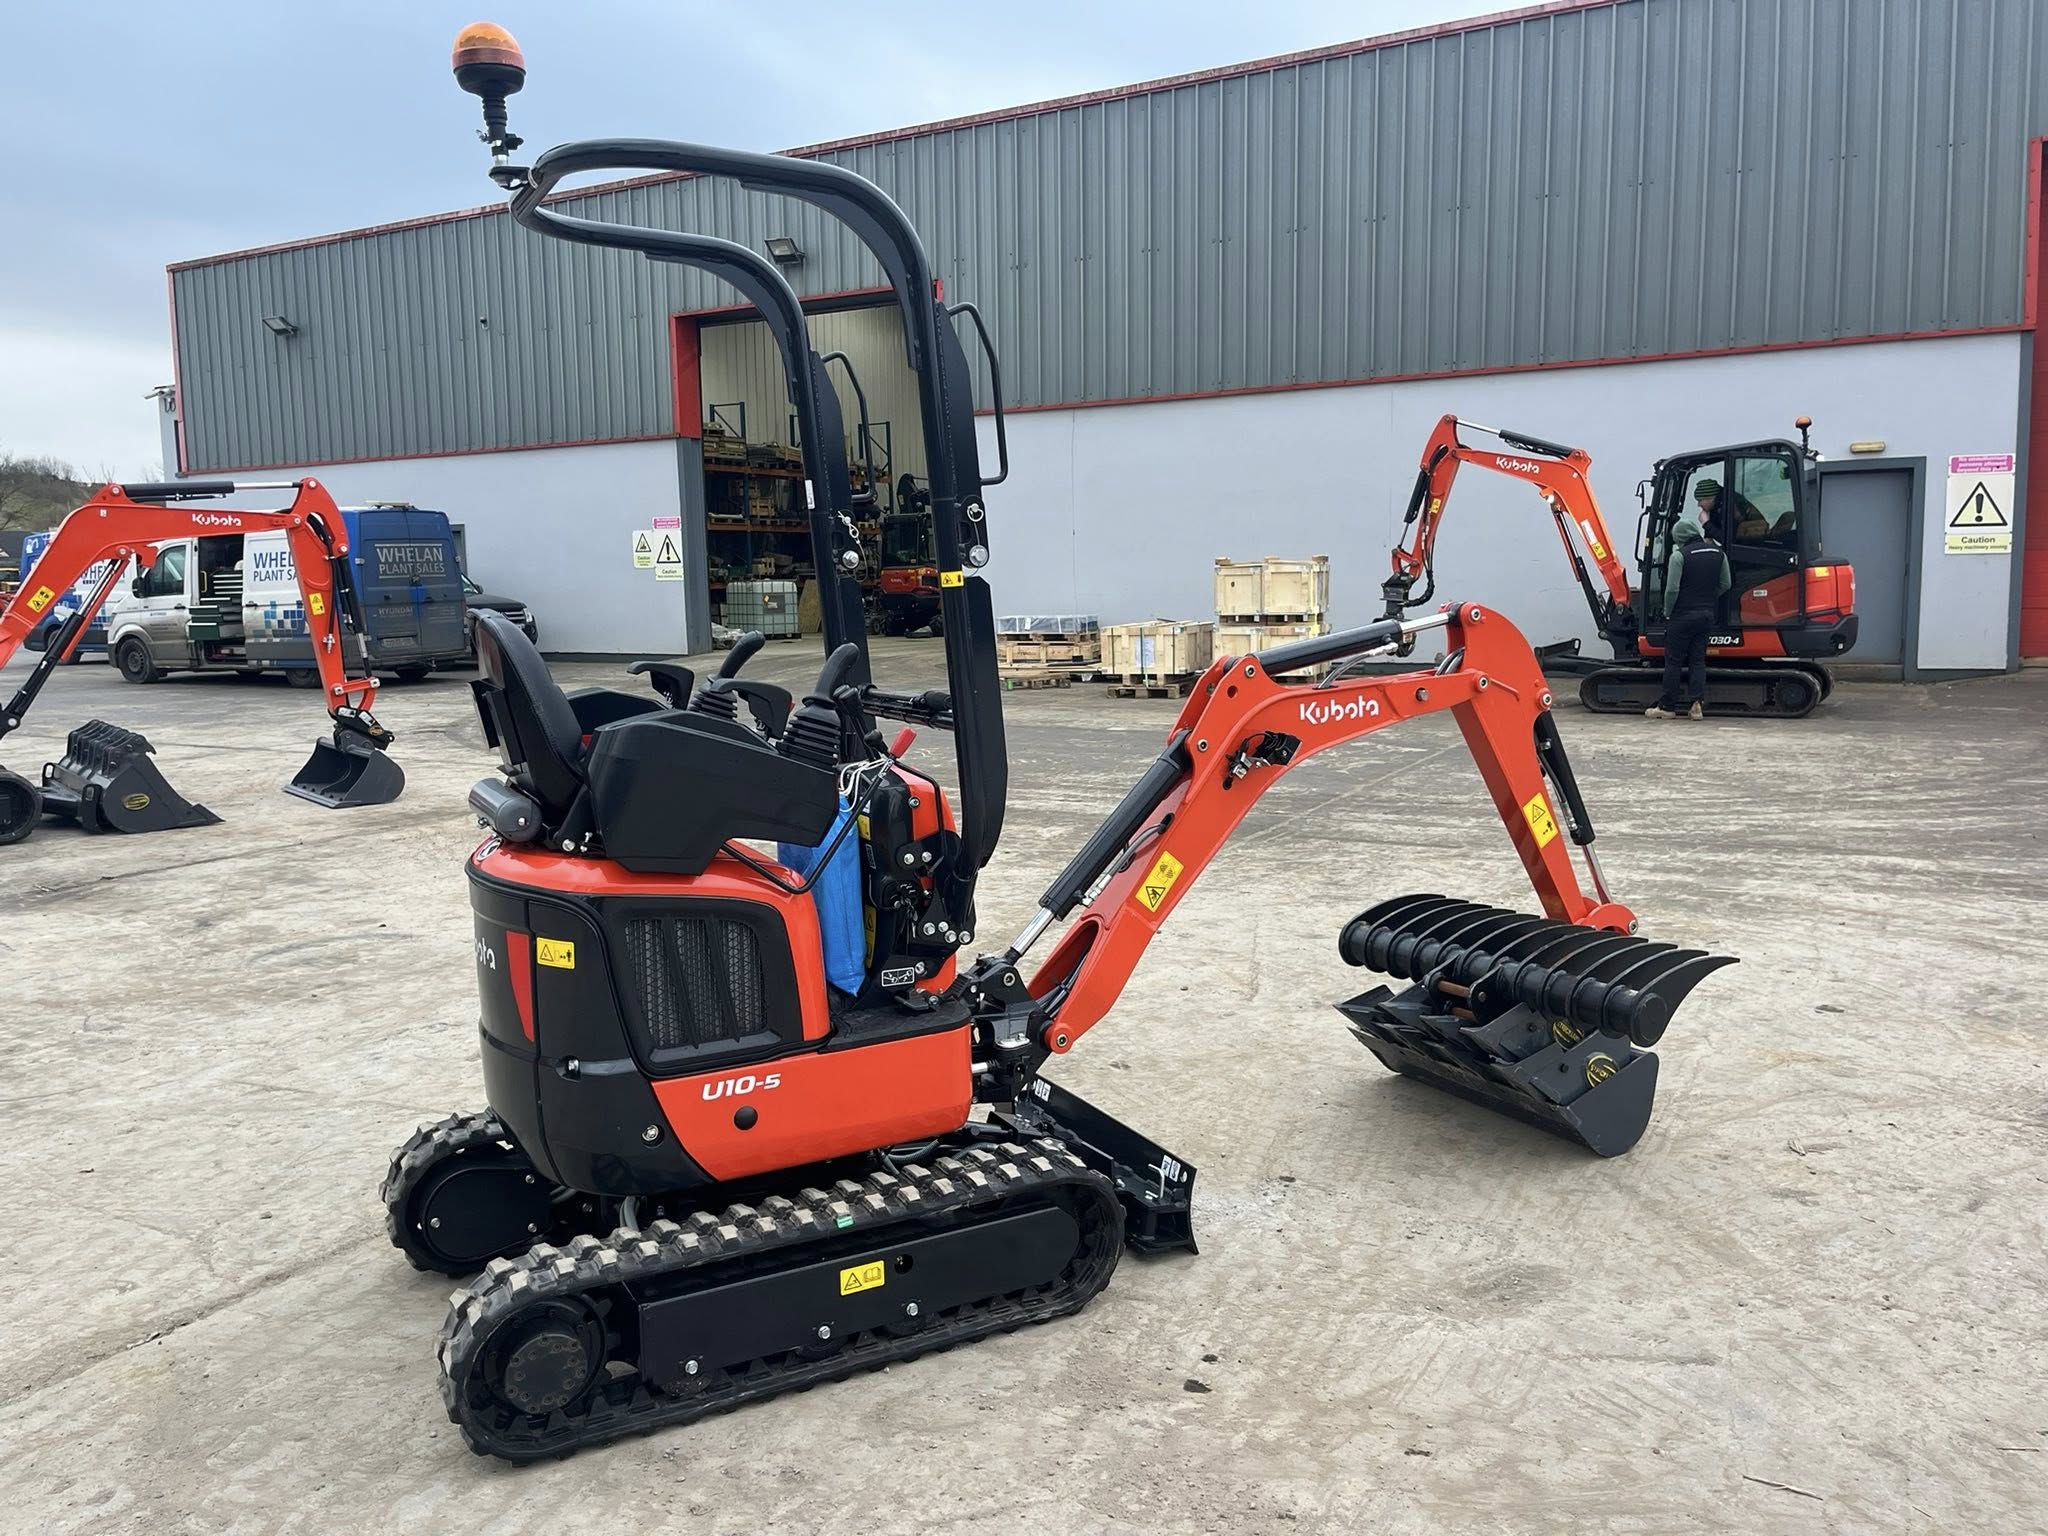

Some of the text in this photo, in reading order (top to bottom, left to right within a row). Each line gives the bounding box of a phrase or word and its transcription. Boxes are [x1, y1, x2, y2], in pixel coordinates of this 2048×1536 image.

[1495, 456, 1540, 474] Kubota
[191, 513, 242, 527] Kubota
[1961, 536, 1996, 544] Caution
[253, 551, 296, 569] WHEL
[376, 547, 443, 562] WHELAN
[253, 569, 285, 582] PLANT
[378, 562, 445, 575] PLANT SALES
[378, 606, 413, 616] HYUNDAI
[1708, 635, 1740, 645] 030-4
[1299, 695, 1379, 725] Kubota
[702, 1073, 781, 1101] U10-5
